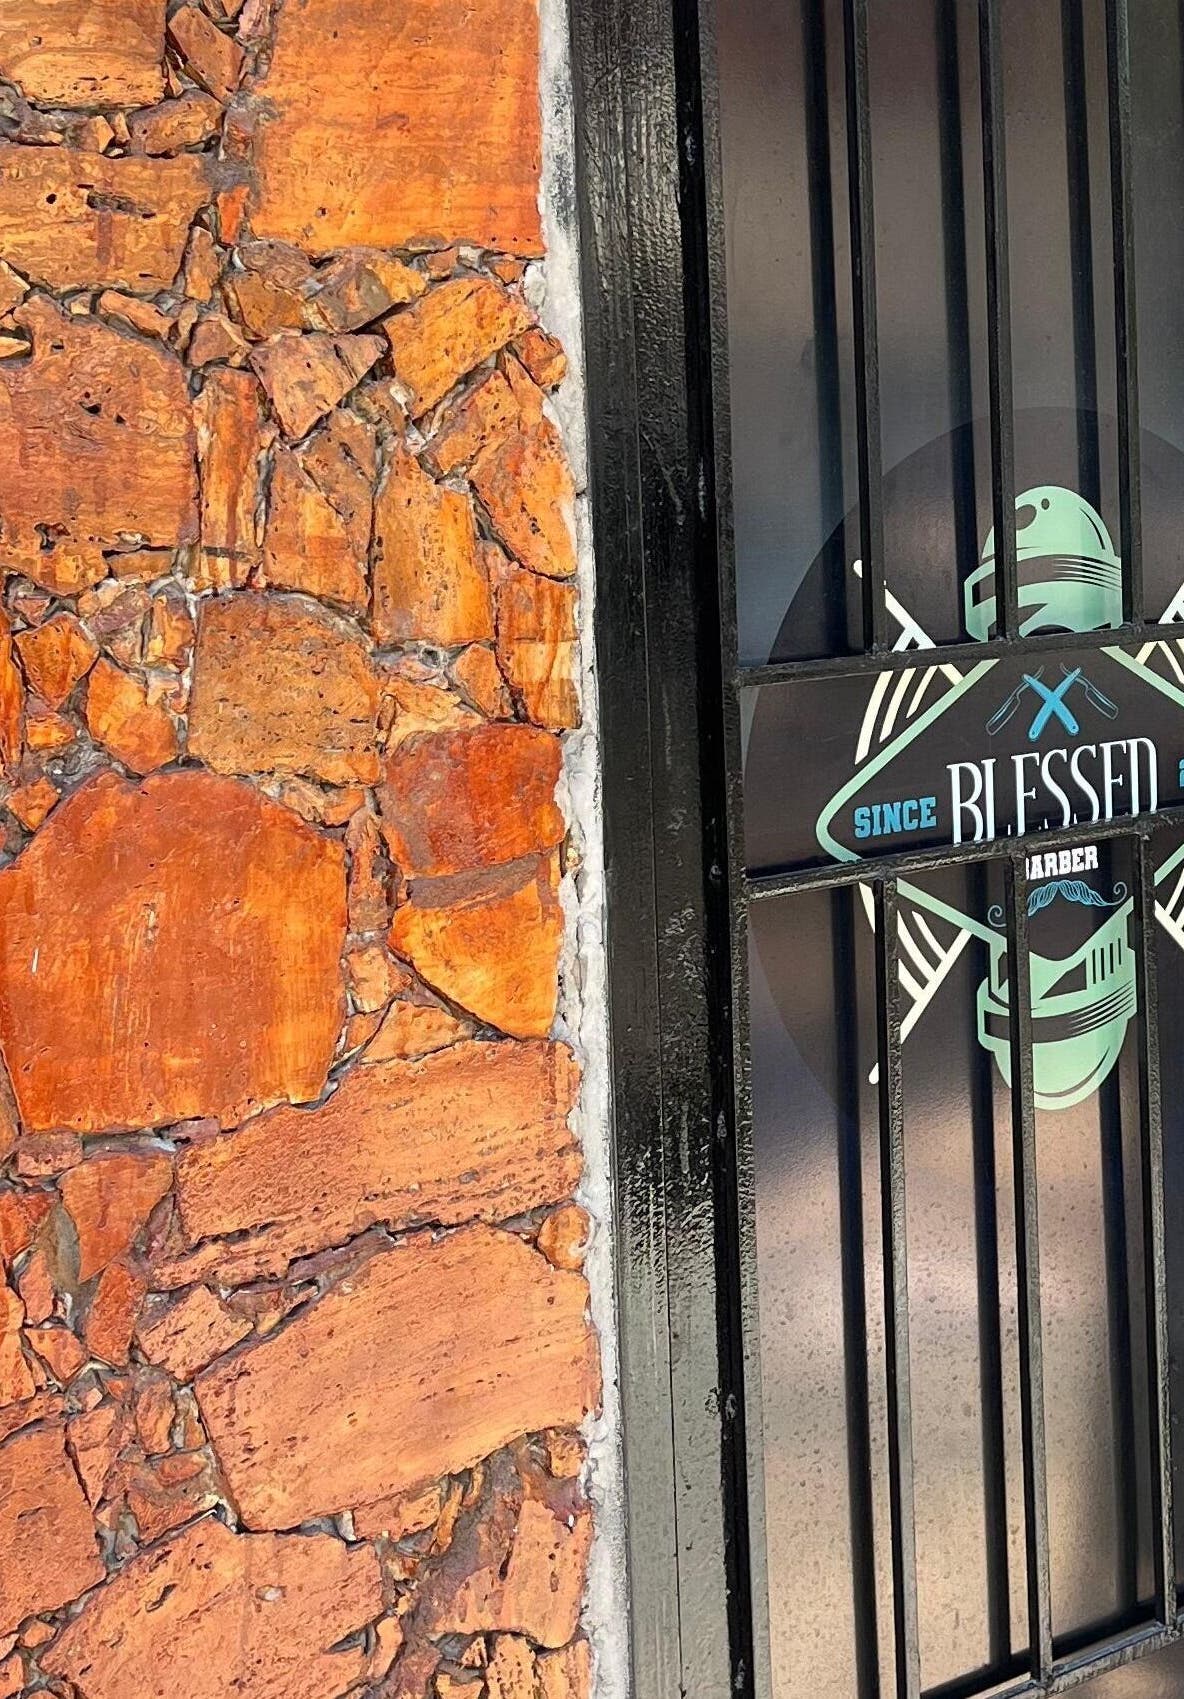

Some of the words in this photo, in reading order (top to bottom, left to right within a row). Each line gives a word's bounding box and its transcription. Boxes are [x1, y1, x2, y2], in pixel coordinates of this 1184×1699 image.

[946, 737, 1158, 847] BLESSED
[853, 796, 937, 839] SINCE
[1025, 845, 1099, 880] ARBER
